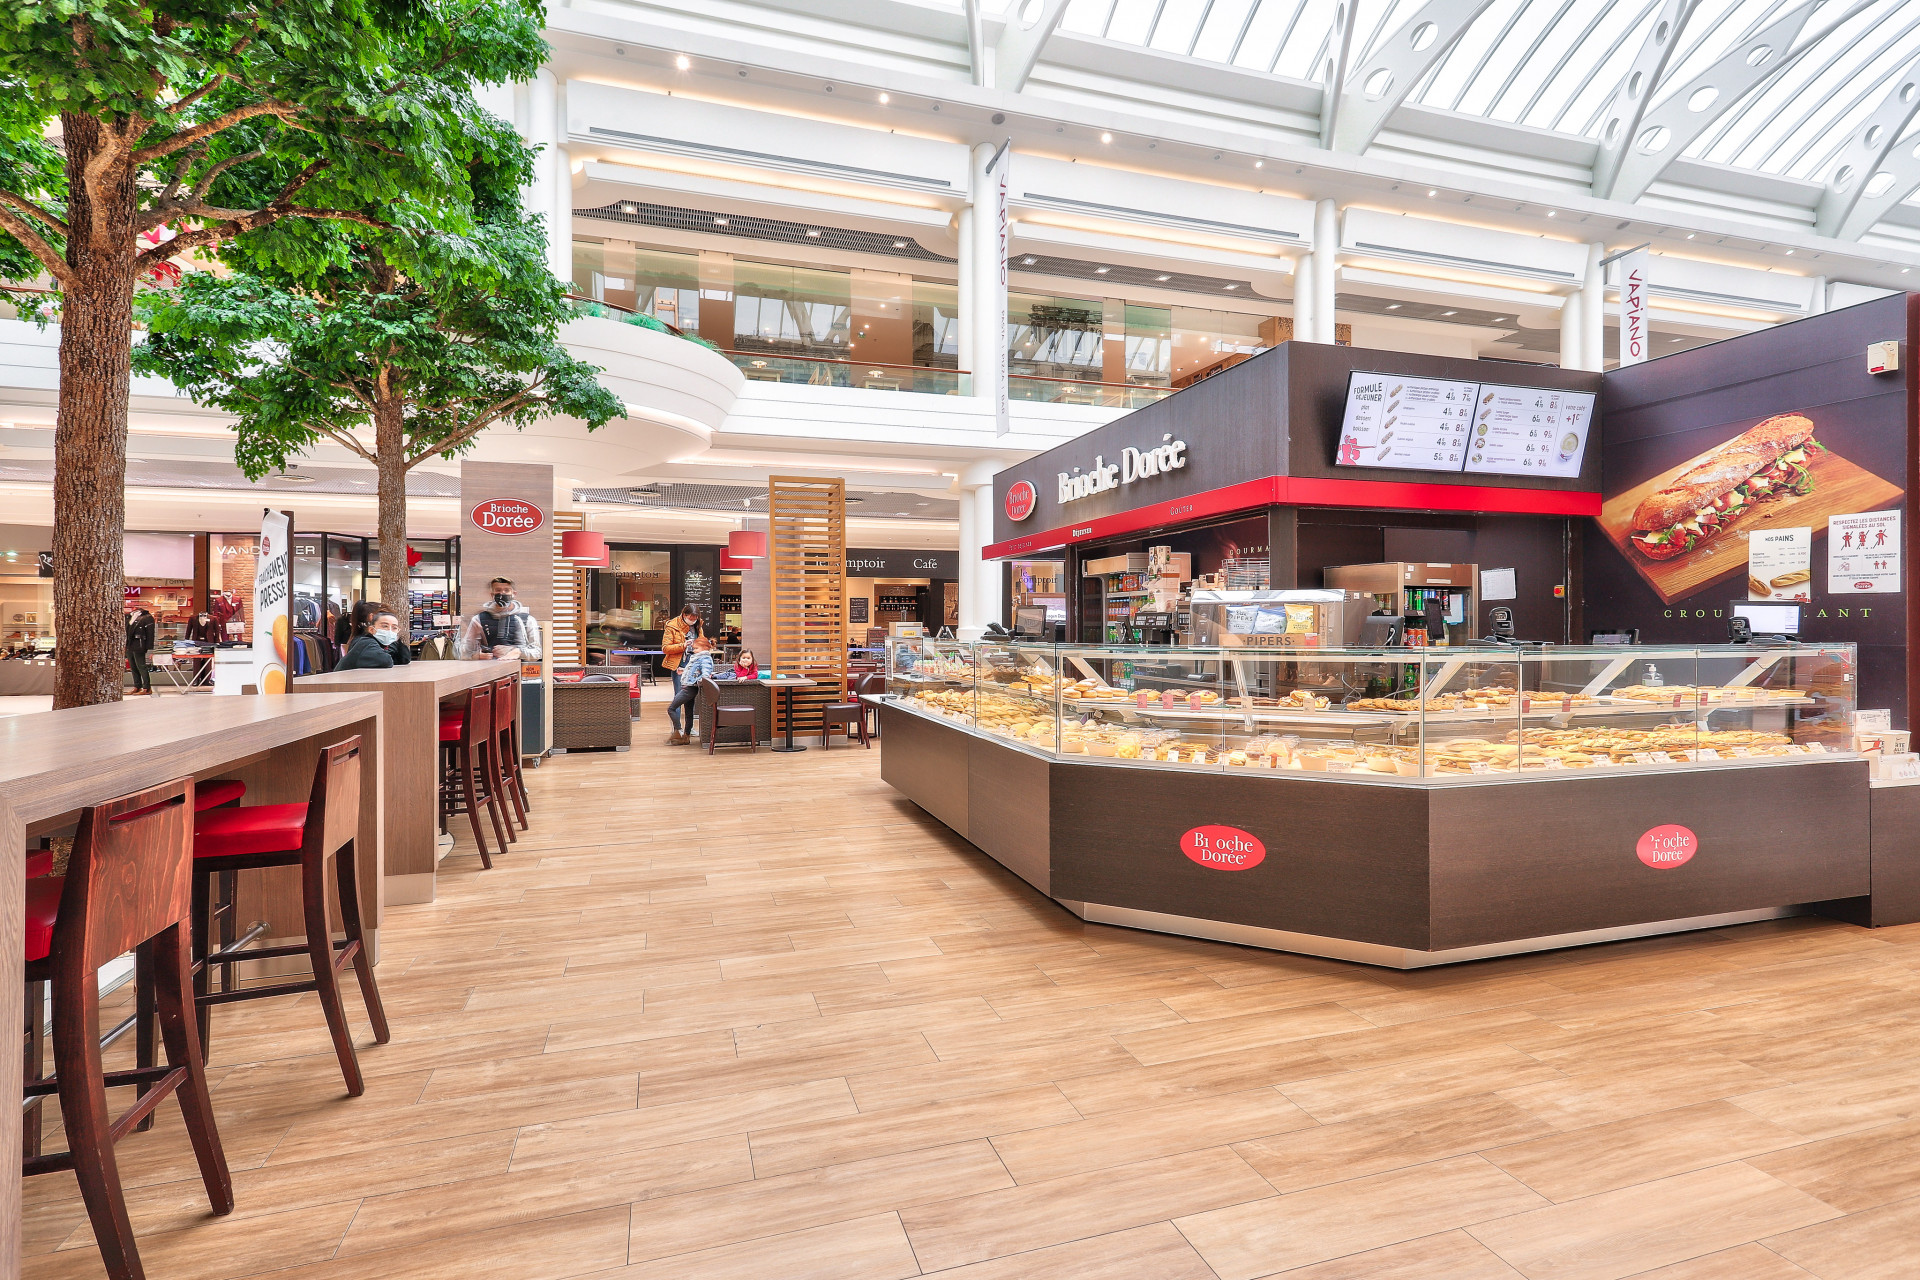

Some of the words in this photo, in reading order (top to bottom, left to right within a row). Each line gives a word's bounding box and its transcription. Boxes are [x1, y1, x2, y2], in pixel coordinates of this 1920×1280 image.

[1353, 382, 1383, 395] FORMULE
[1058, 455, 1119, 504] Brioche
[1121, 433, 1187, 485] Dorée
[1008, 486, 1030, 505] Brioche
[490, 503, 529, 514] Brioche
[482, 511, 534, 528] Dorée
[1774, 534, 1795, 542] PAINS
[611, 561, 621, 571] le
[913, 558, 938, 569] Café
[610, 568, 660, 581] comptoir
[1020, 568, 1028, 577] le
[1018, 575, 1058, 586] comptoir
[1201, 848, 1244, 865] Dorée
[1652, 848, 1683, 863] Dorée
